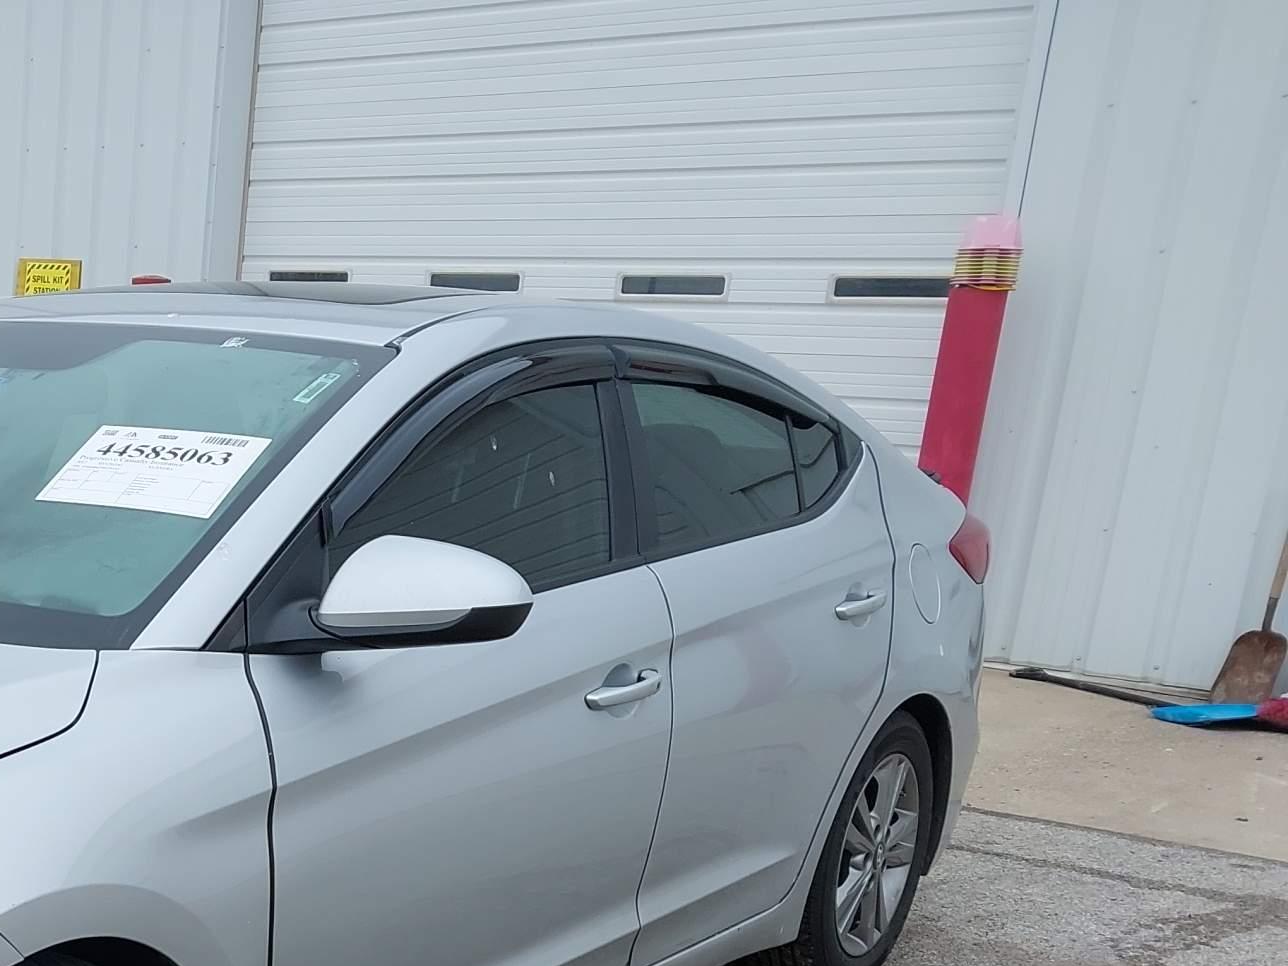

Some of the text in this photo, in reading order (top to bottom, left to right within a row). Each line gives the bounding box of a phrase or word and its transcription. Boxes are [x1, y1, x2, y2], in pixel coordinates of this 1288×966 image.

[32, 275, 64, 284] SPILL KIT
[96, 442, 233, 467] 44585063
